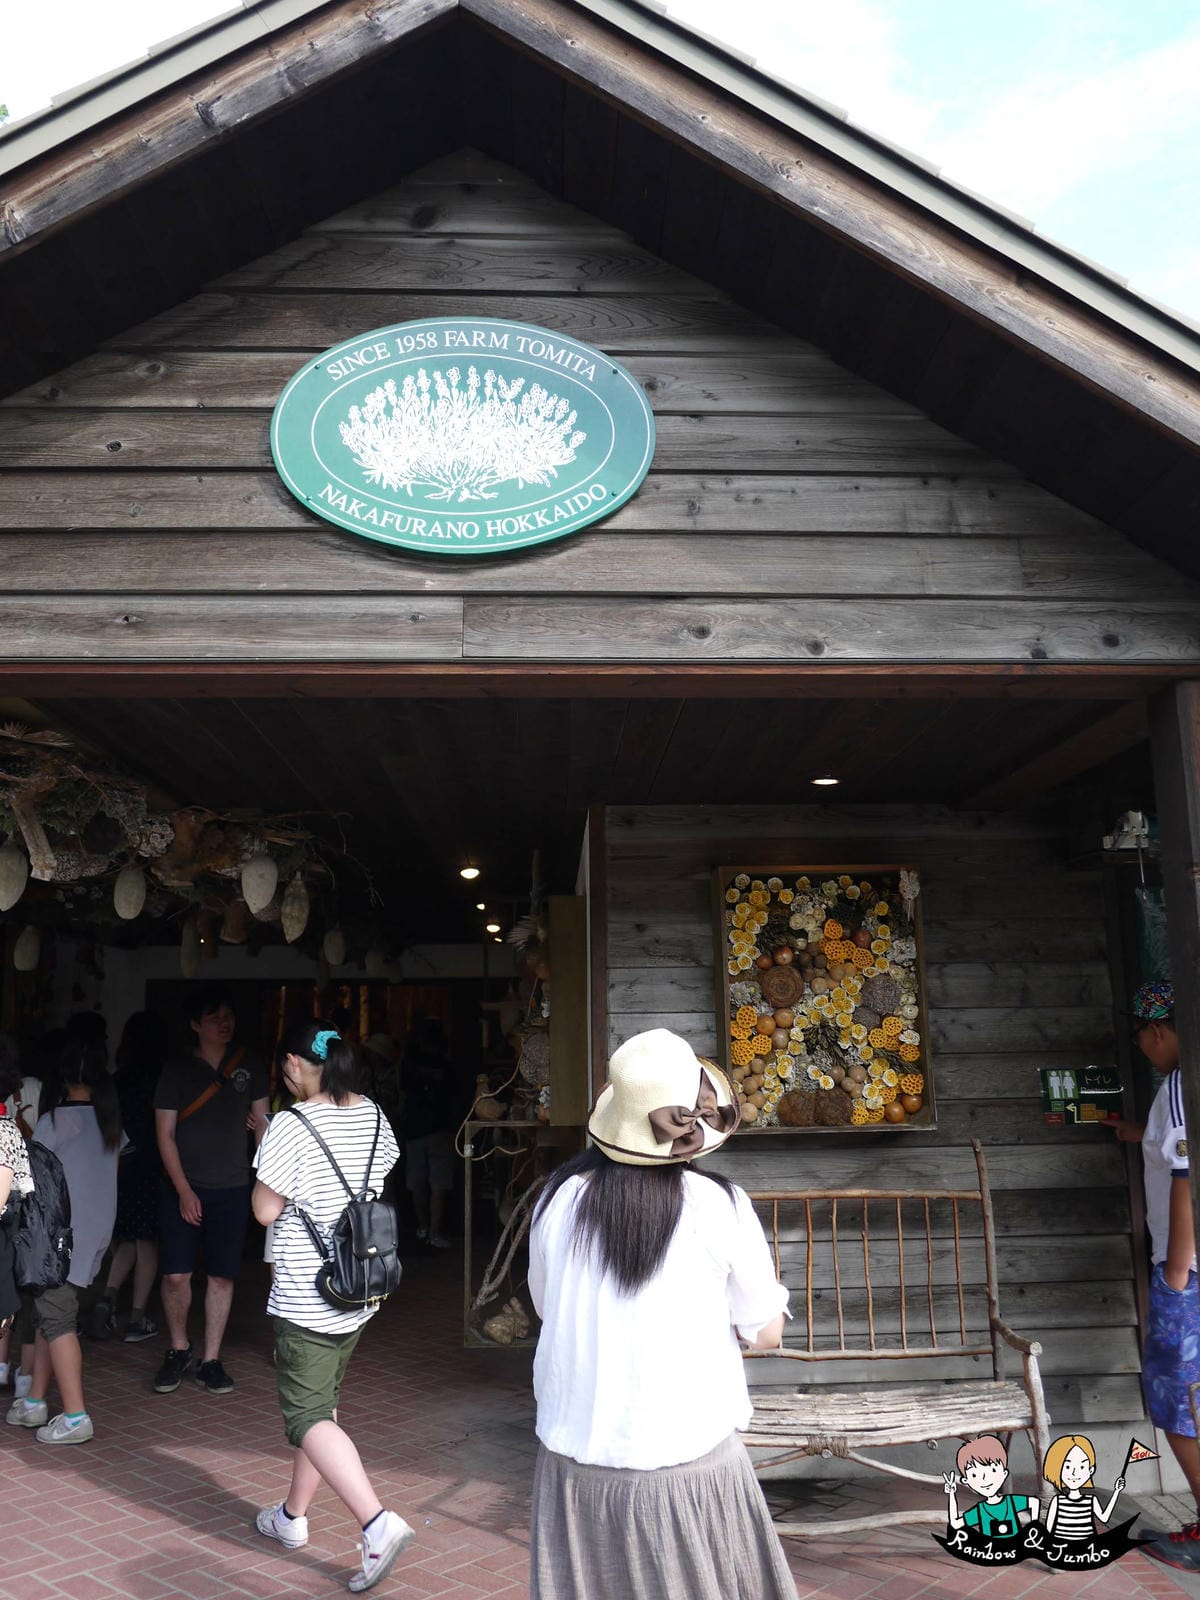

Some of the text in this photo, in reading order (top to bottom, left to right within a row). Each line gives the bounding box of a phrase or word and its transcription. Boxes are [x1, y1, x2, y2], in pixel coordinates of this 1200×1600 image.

[326, 330, 597, 382] SINCE 1958 FARM TOMITA
[318, 483, 607, 539] NAKAFURANO HOKKAIDO
[1085, 1075, 1112, 1085] トイレ
